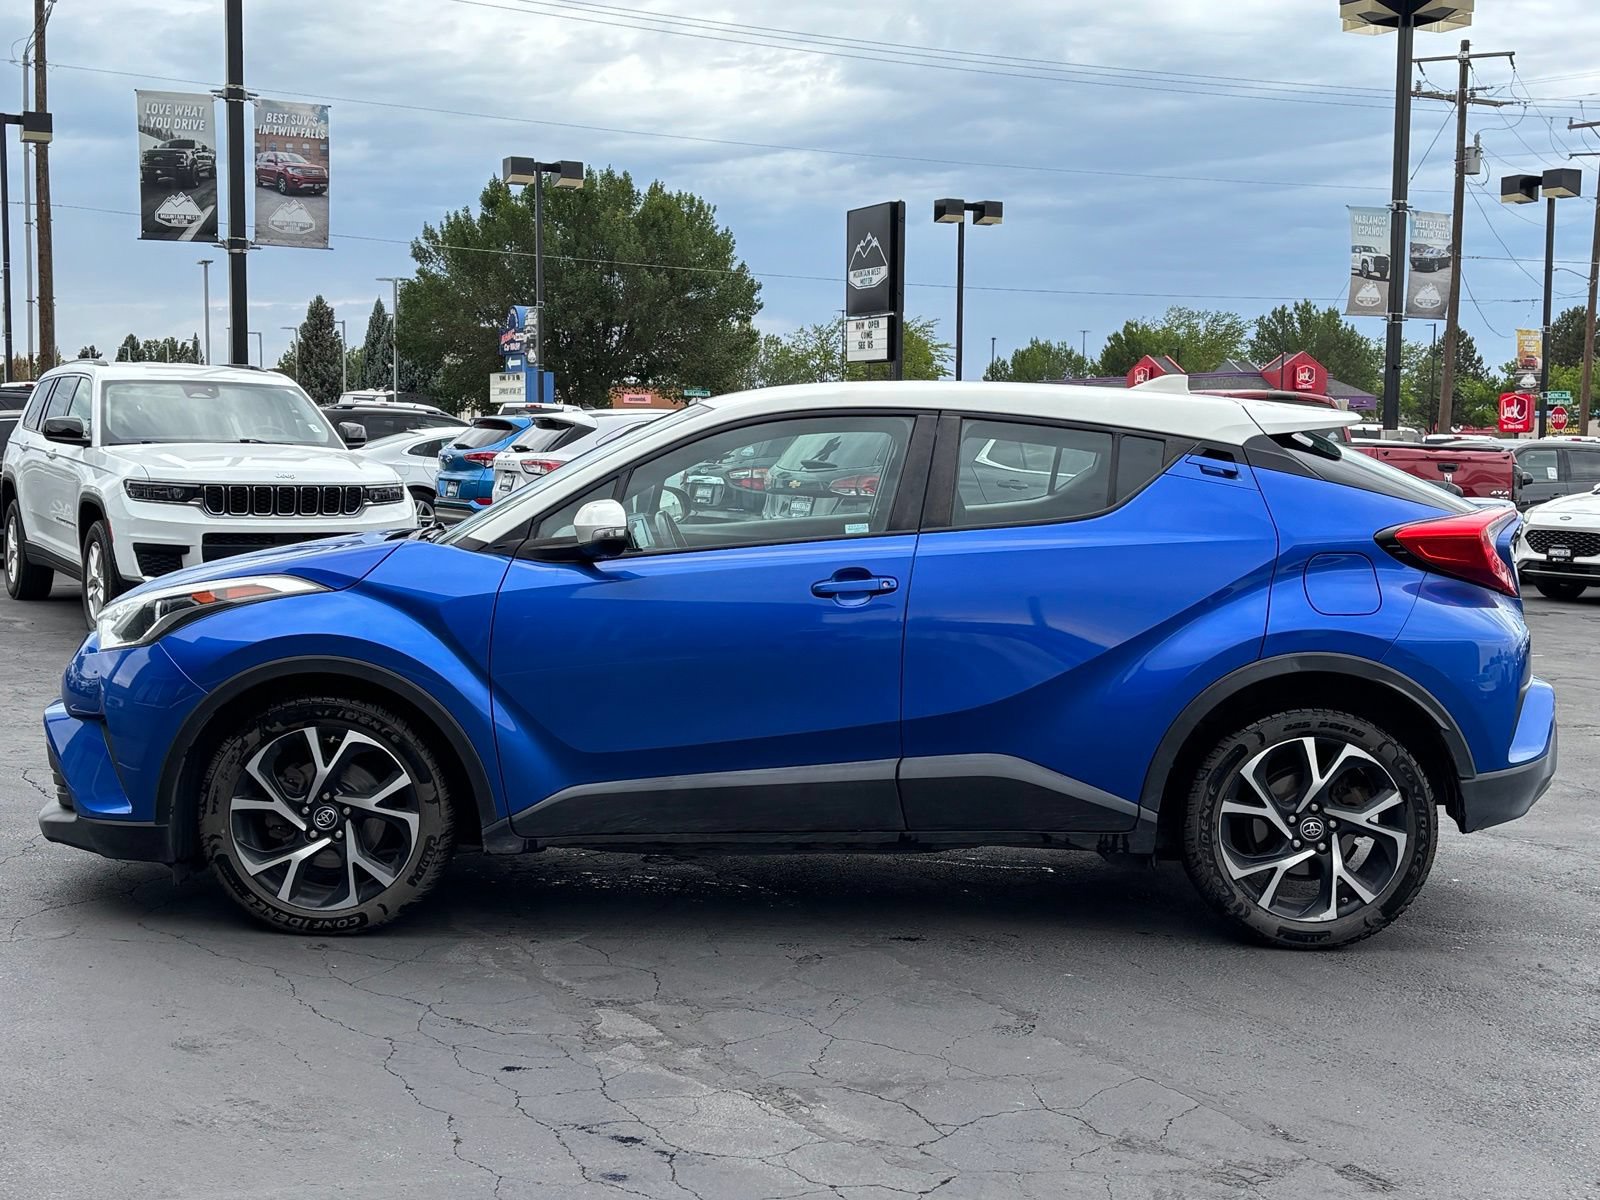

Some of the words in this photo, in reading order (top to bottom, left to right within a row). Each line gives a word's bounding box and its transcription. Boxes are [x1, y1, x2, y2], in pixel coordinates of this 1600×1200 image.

[146, 103, 171, 115] LOVE
[174, 104, 204, 117] WHAT
[150, 116, 171, 128] YOU
[173, 118, 205, 131] DRIVE
[266, 112, 289, 124] BEST
[290, 114, 318, 127] SUV'S
[258, 124, 270, 135] IN
[273, 125, 298, 137] TWIN
[300, 128, 326, 140] FALLS
[1354, 215, 1386, 225] HABLAMOS
[1415, 220, 1428, 229] BEST
[1420, 229, 1433, 238] TWIN
[868, 320, 880, 329] OPEN
[1502, 399, 1526, 420] Jack
[1552, 414, 1567, 424] STOP
